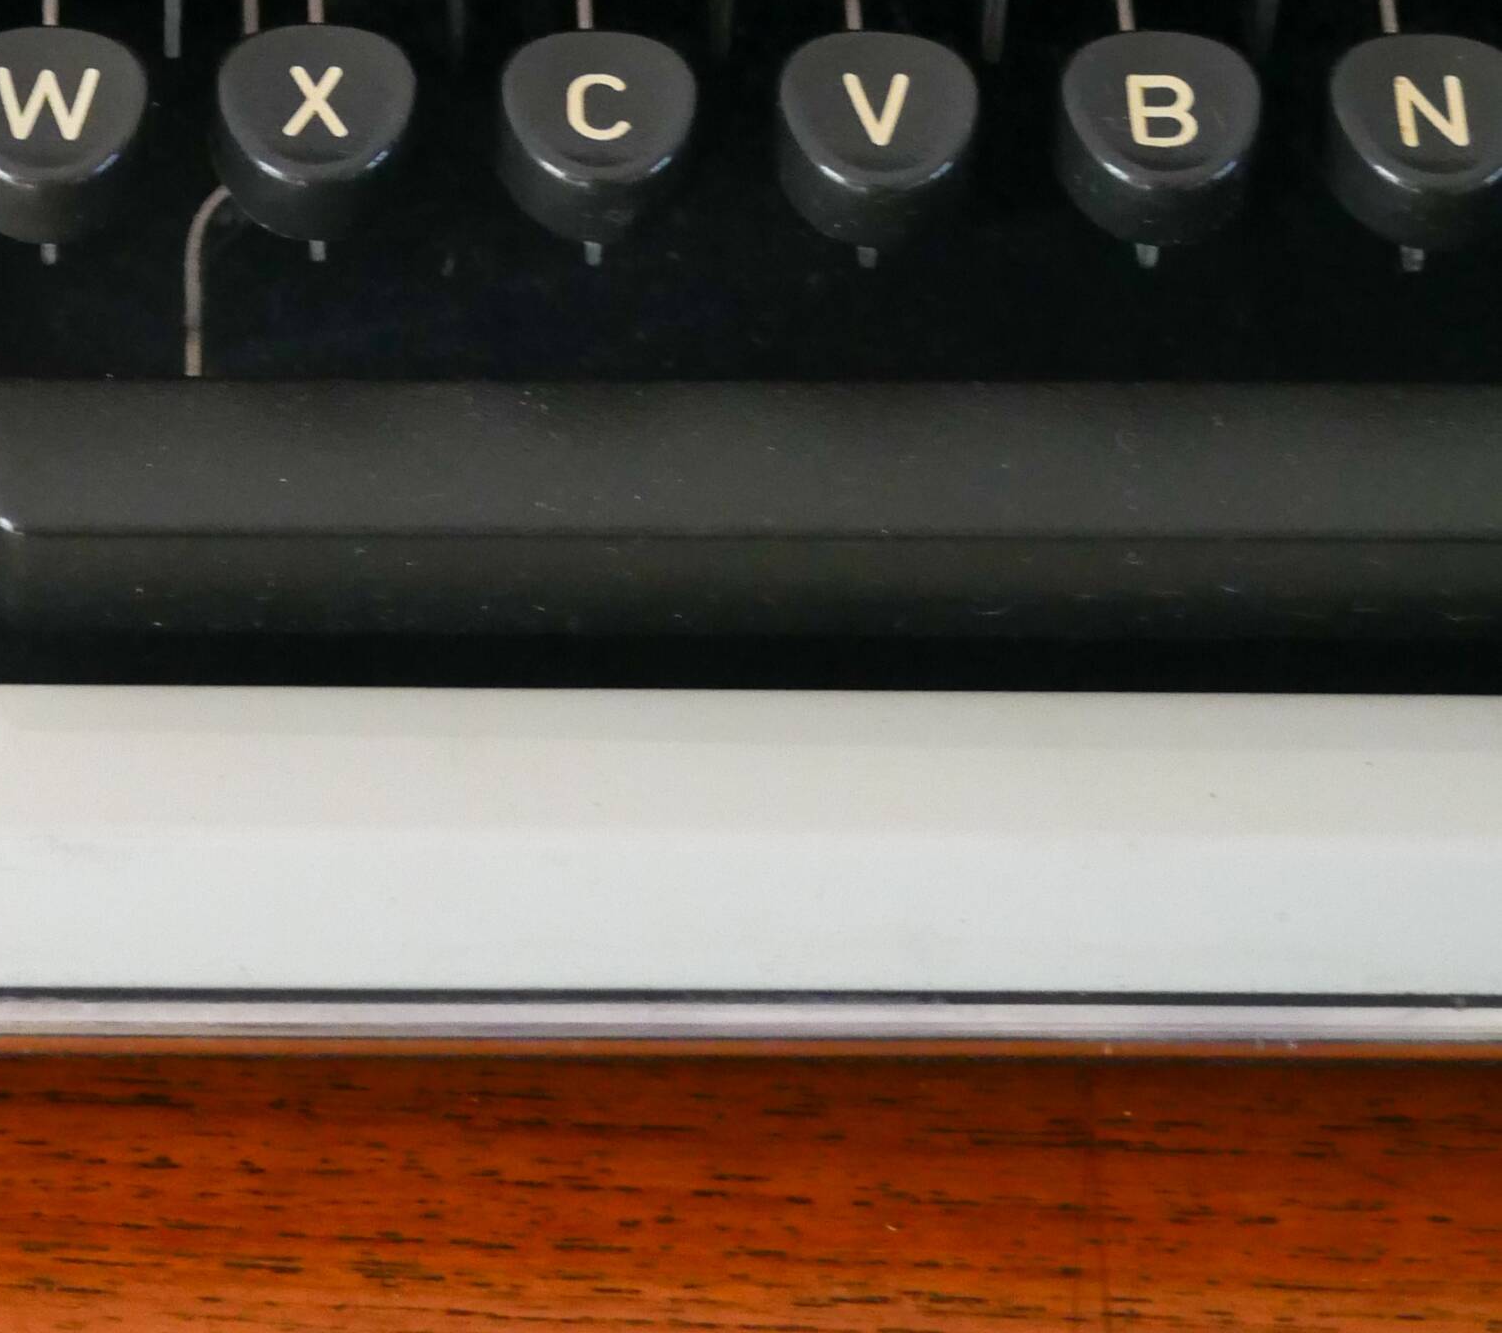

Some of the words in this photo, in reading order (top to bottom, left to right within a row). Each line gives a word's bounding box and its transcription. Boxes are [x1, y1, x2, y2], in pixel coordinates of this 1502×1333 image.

[282, 66, 348, 137] X
[567, 74, 631, 140] C
[843, 73, 909, 146] V
[1126, 75, 1198, 147] B
[1394, 75, 1469, 147] N
